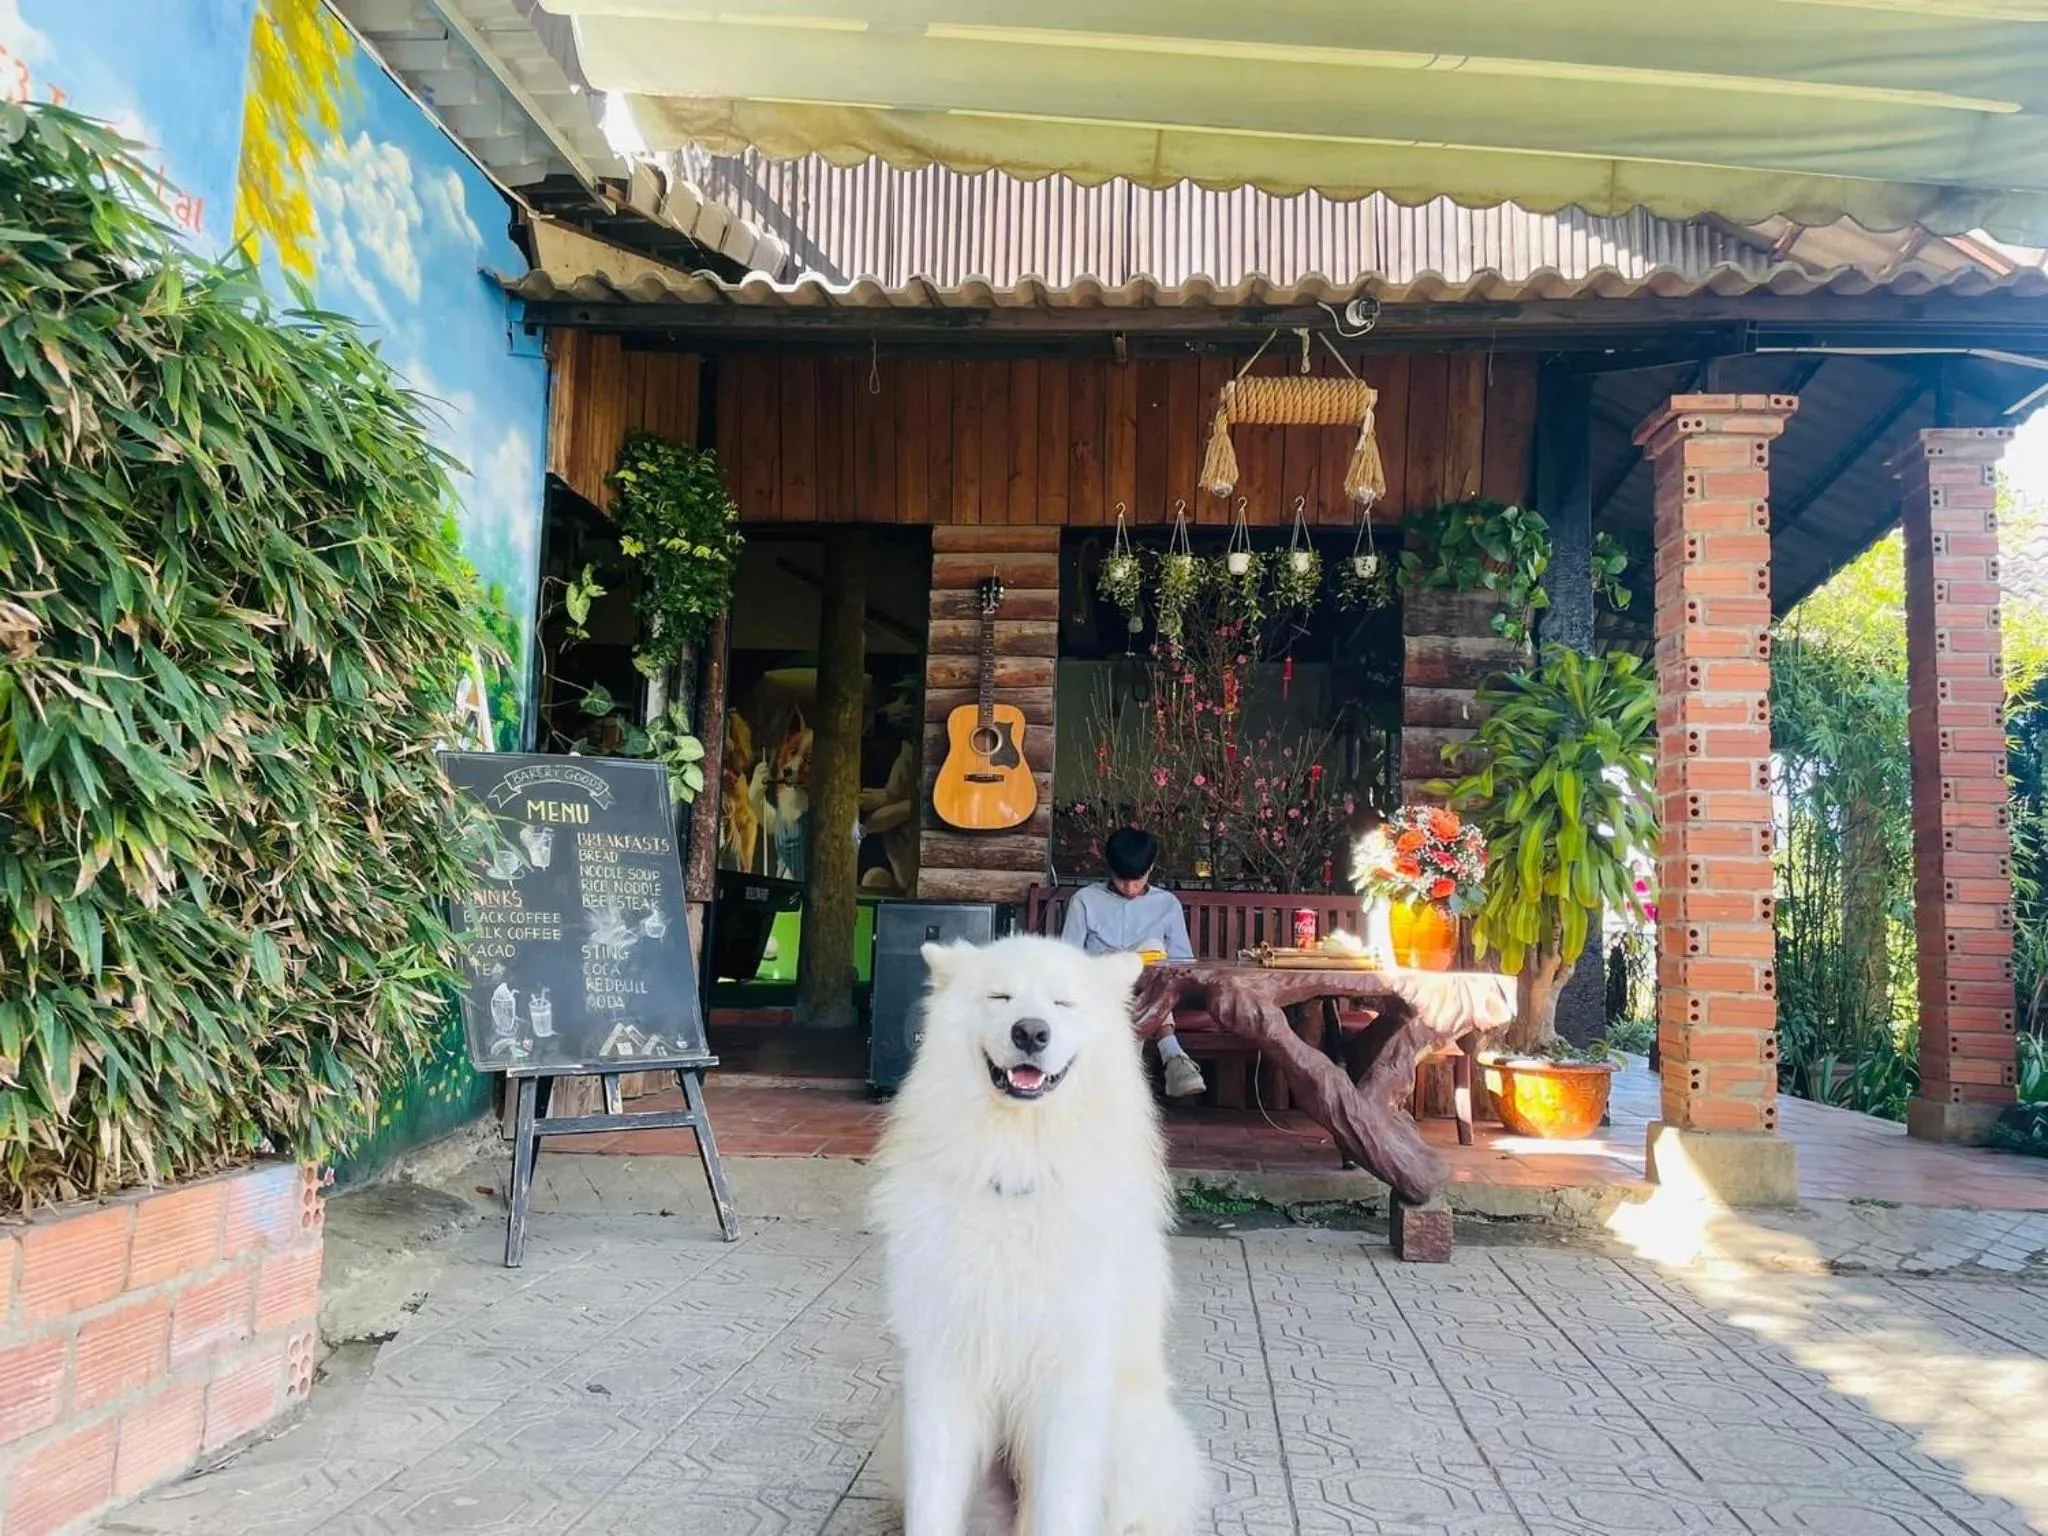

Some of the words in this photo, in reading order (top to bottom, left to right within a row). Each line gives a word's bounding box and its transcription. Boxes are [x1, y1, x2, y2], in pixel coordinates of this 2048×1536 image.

[512, 767, 559, 784] BAKERY
[564, 769, 604, 791] GOODS
[527, 799, 590, 825] MENU
[577, 832, 670, 852] BREAKFASTS
[579, 849, 618, 863] BREAD
[580, 865, 624, 879] NOODLE
[627, 868, 660, 880] SOUP
[613, 880, 661, 896] NOODLE
[463, 889, 523, 908] RINKS
[616, 896, 661, 911] STEAK
[463, 910, 506, 924] BACK
[509, 911, 561, 924] COFFEE
[507, 926, 561, 940] COFFEE
[467, 943, 516, 958] CACAO
[581, 943, 631, 960] STING
[583, 962, 621, 976] COCA
[585, 977, 648, 994] REDBULL
